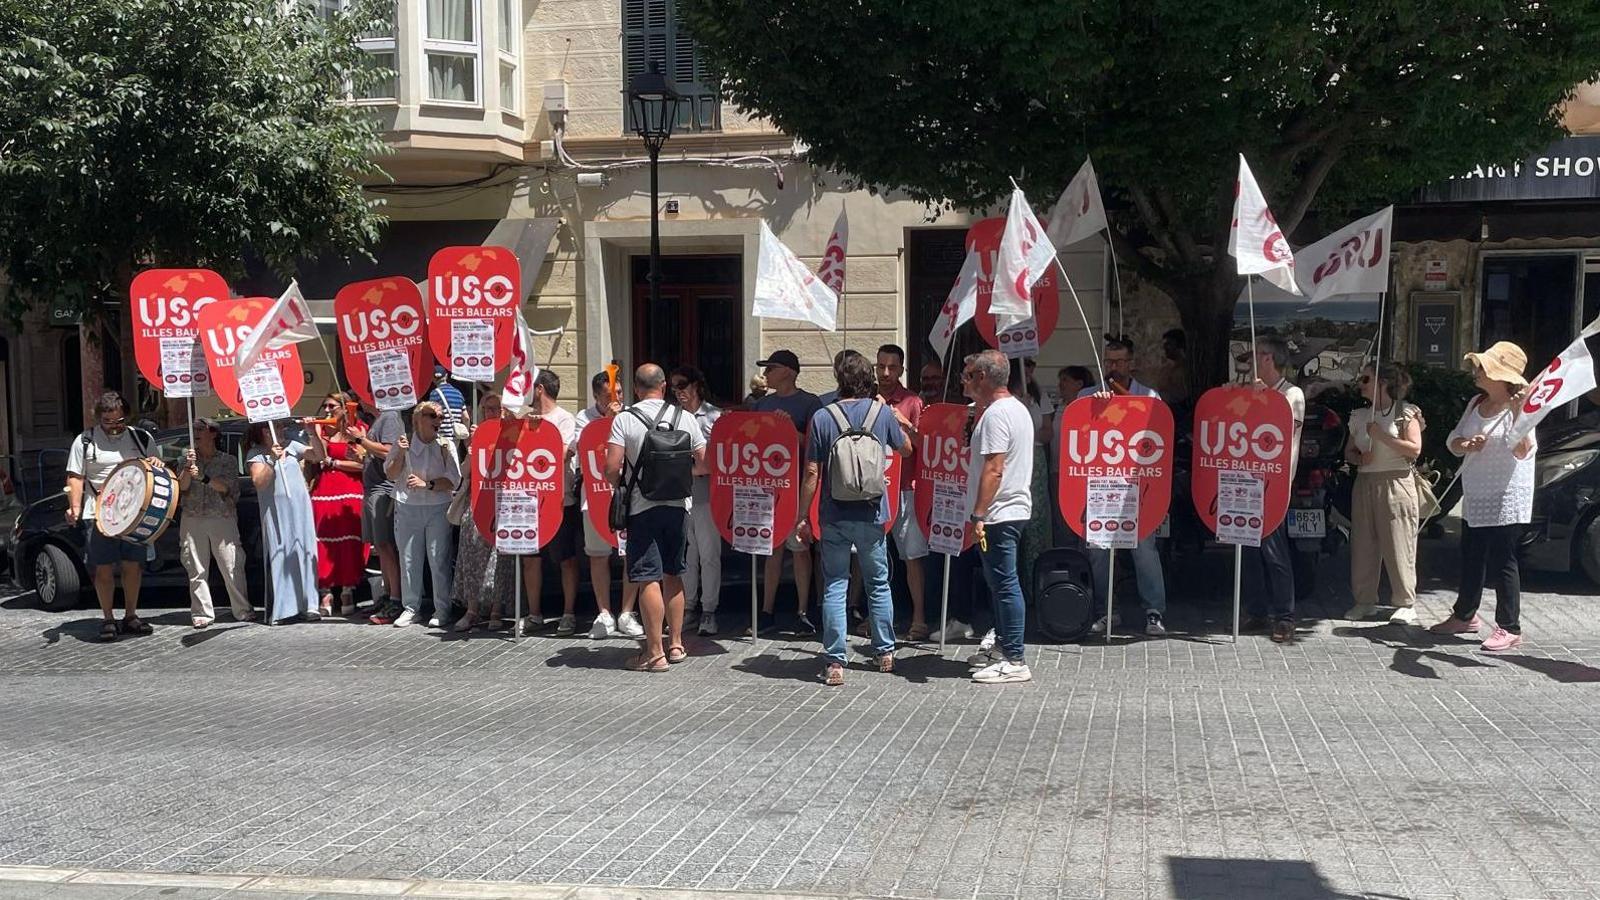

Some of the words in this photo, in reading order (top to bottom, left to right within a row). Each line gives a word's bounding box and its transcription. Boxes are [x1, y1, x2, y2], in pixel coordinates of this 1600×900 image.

[434, 274, 514, 306] USO
[436, 307, 464, 317] ILLES
[466, 307, 513, 317] BALEARS
[342, 304, 420, 342] USO
[142, 328, 173, 338] ILLES
[206, 325, 254, 356] US
[349, 342, 377, 354] ILLES
[378, 335, 423, 351] BALEARS
[215, 356, 236, 367] ILL
[257, 350, 292, 362] LEARS
[1068, 429, 1165, 465] USO
[1200, 420, 1285, 460] USO
[478, 448, 556, 480] USO
[716, 442, 791, 477] USO
[1200, 457, 1229, 470] ILLES
[1231, 460, 1282, 474] BALEARS
[921, 469, 944, 481] ILLES
[944, 473, 968, 485] BALE
[1068, 466, 1103, 477] ILLES
[1107, 466, 1162, 478] BALEARS
[479, 480, 507, 491] ILLES
[509, 481, 556, 491] BALEARS
[717, 476, 744, 487] ILLES
[746, 477, 791, 489] BALEARS
